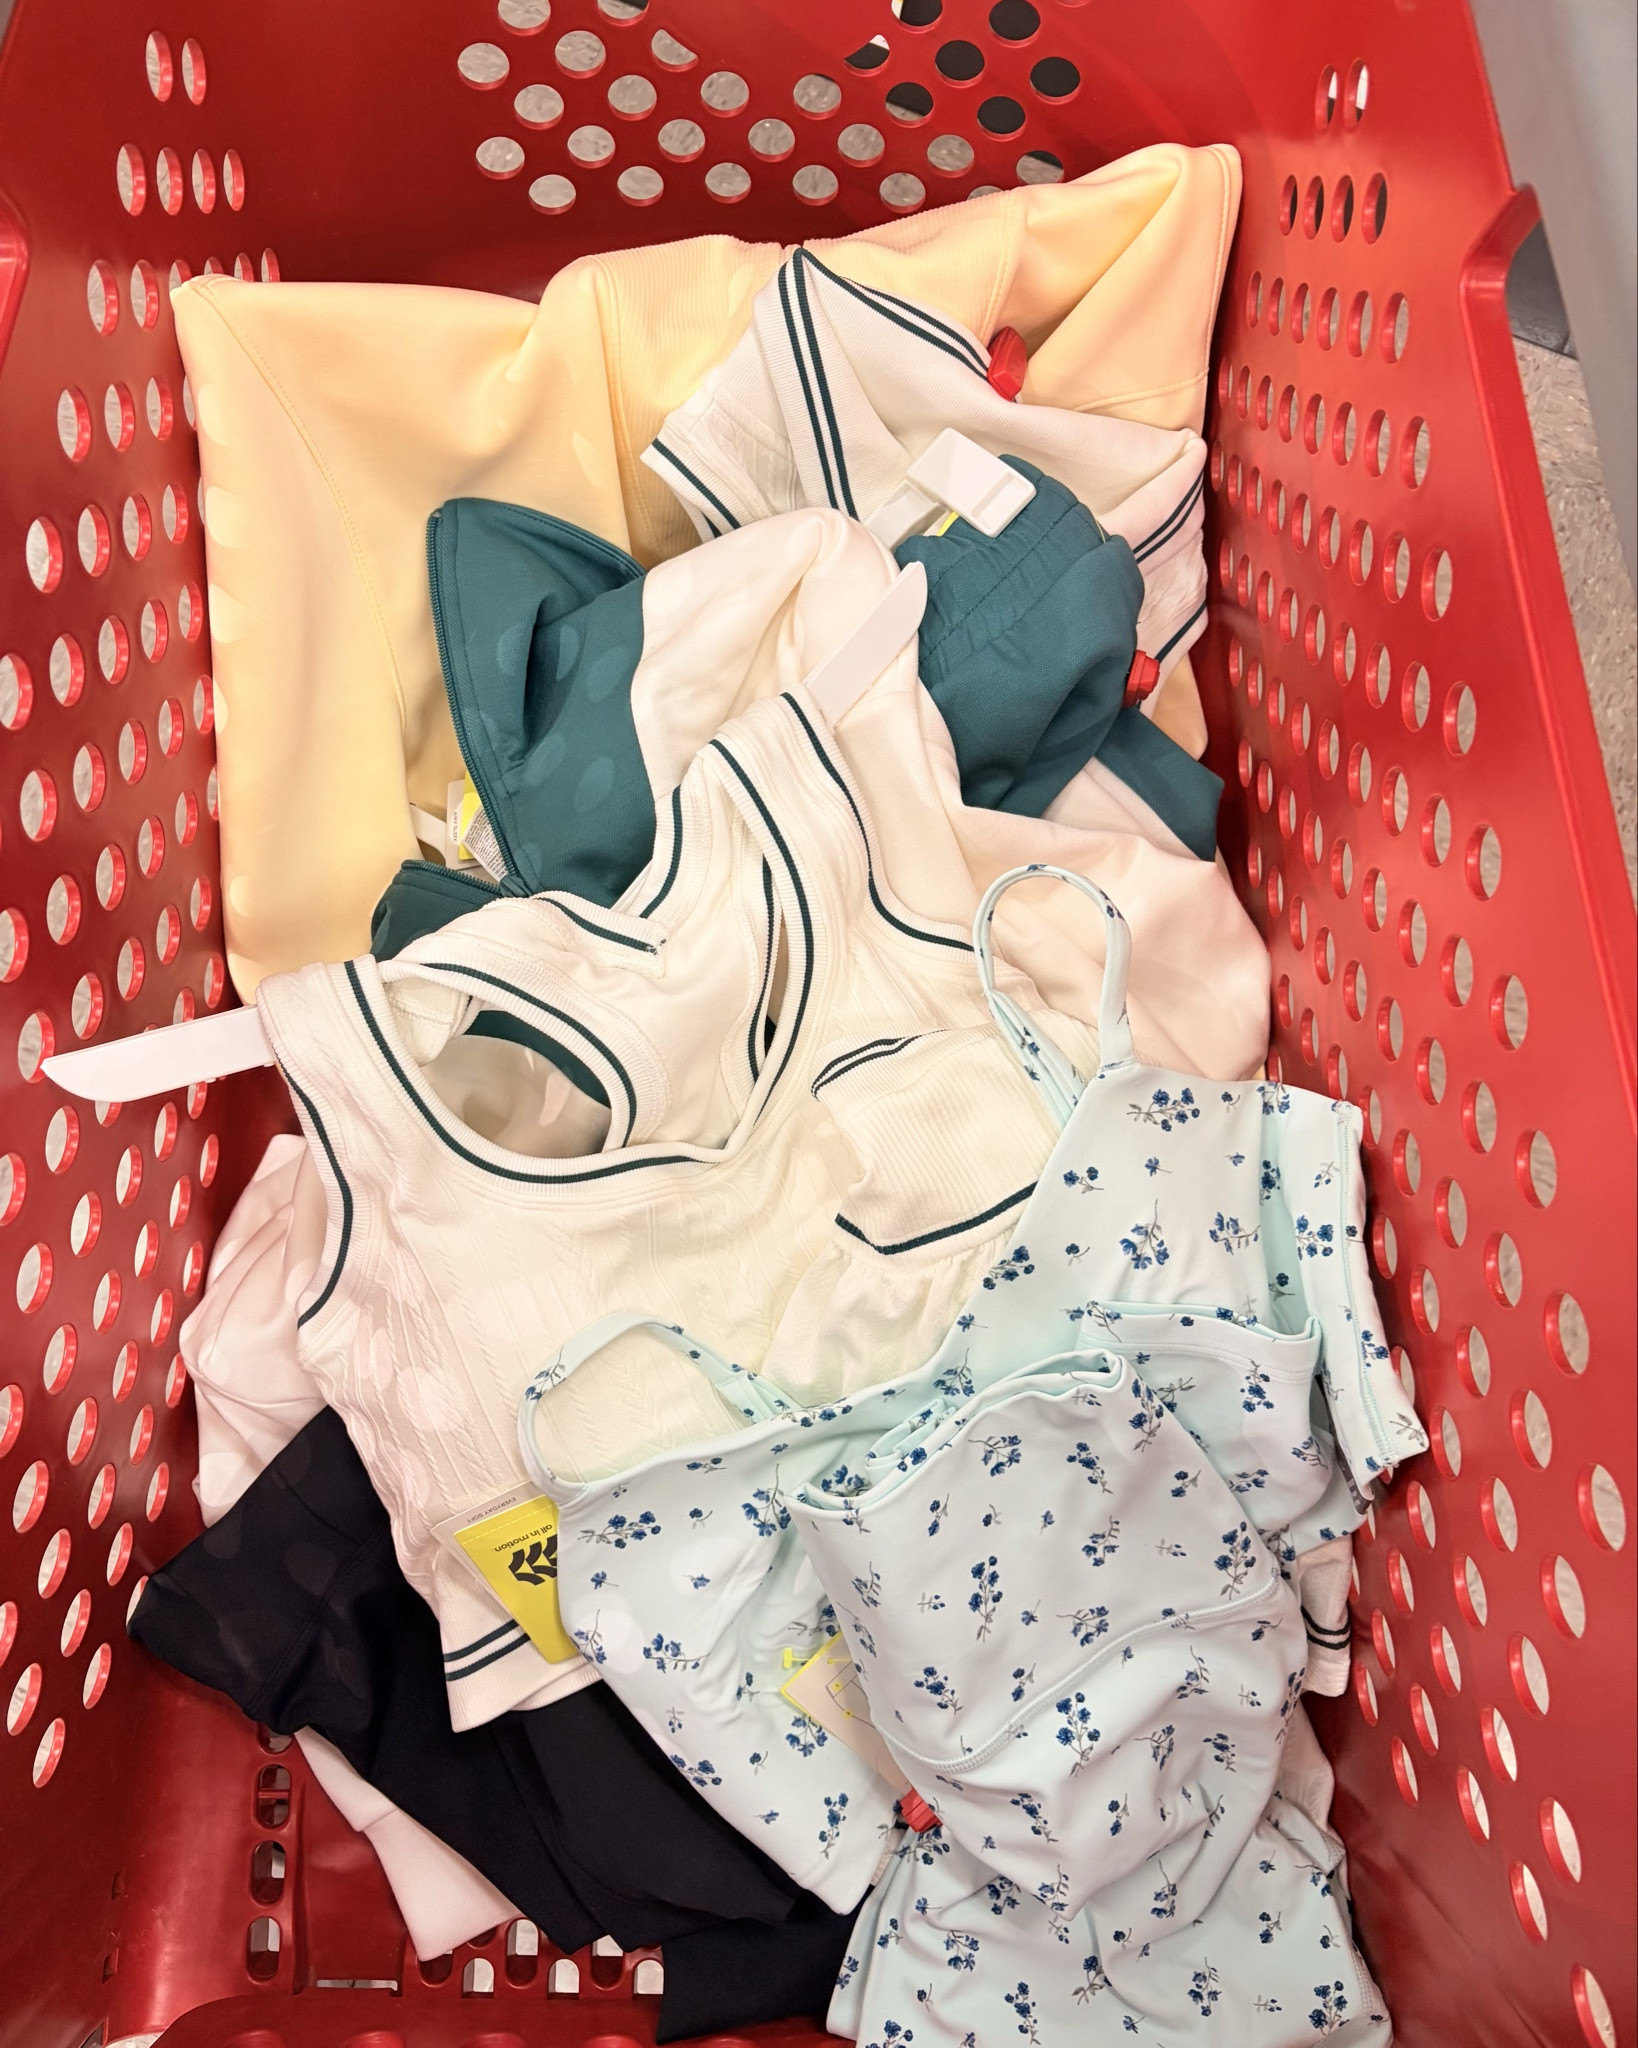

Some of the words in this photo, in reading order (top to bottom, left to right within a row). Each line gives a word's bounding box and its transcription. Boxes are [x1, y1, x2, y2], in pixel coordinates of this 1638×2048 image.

[484, 1496, 517, 1515] EVERYDAY
[466, 1513, 484, 1524] SOFT
[540, 1524, 553, 1534] all
